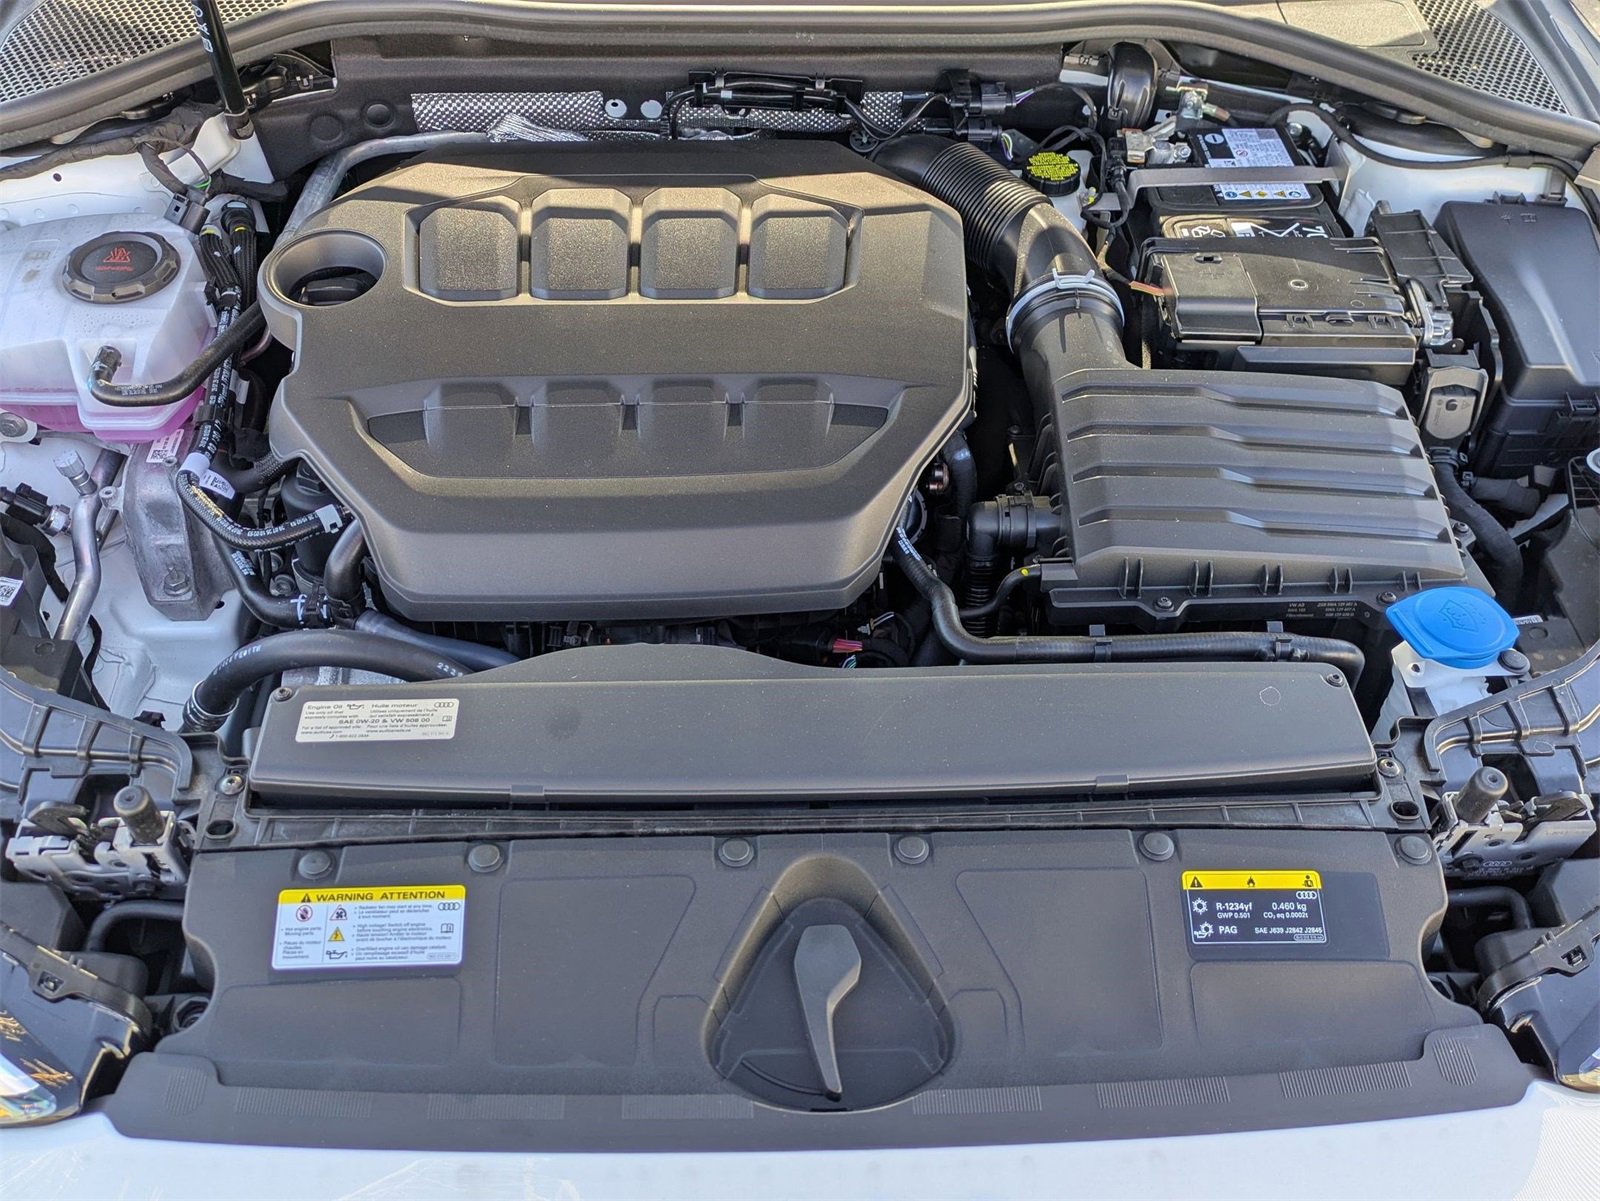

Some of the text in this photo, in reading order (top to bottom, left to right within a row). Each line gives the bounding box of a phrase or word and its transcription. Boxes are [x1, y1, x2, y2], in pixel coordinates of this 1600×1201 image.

[316, 890, 445, 902] WARNING ATTENTION
[1216, 902, 1307, 912] R-1234yf 0.460 kg
[1218, 926, 1238, 934] PAG
